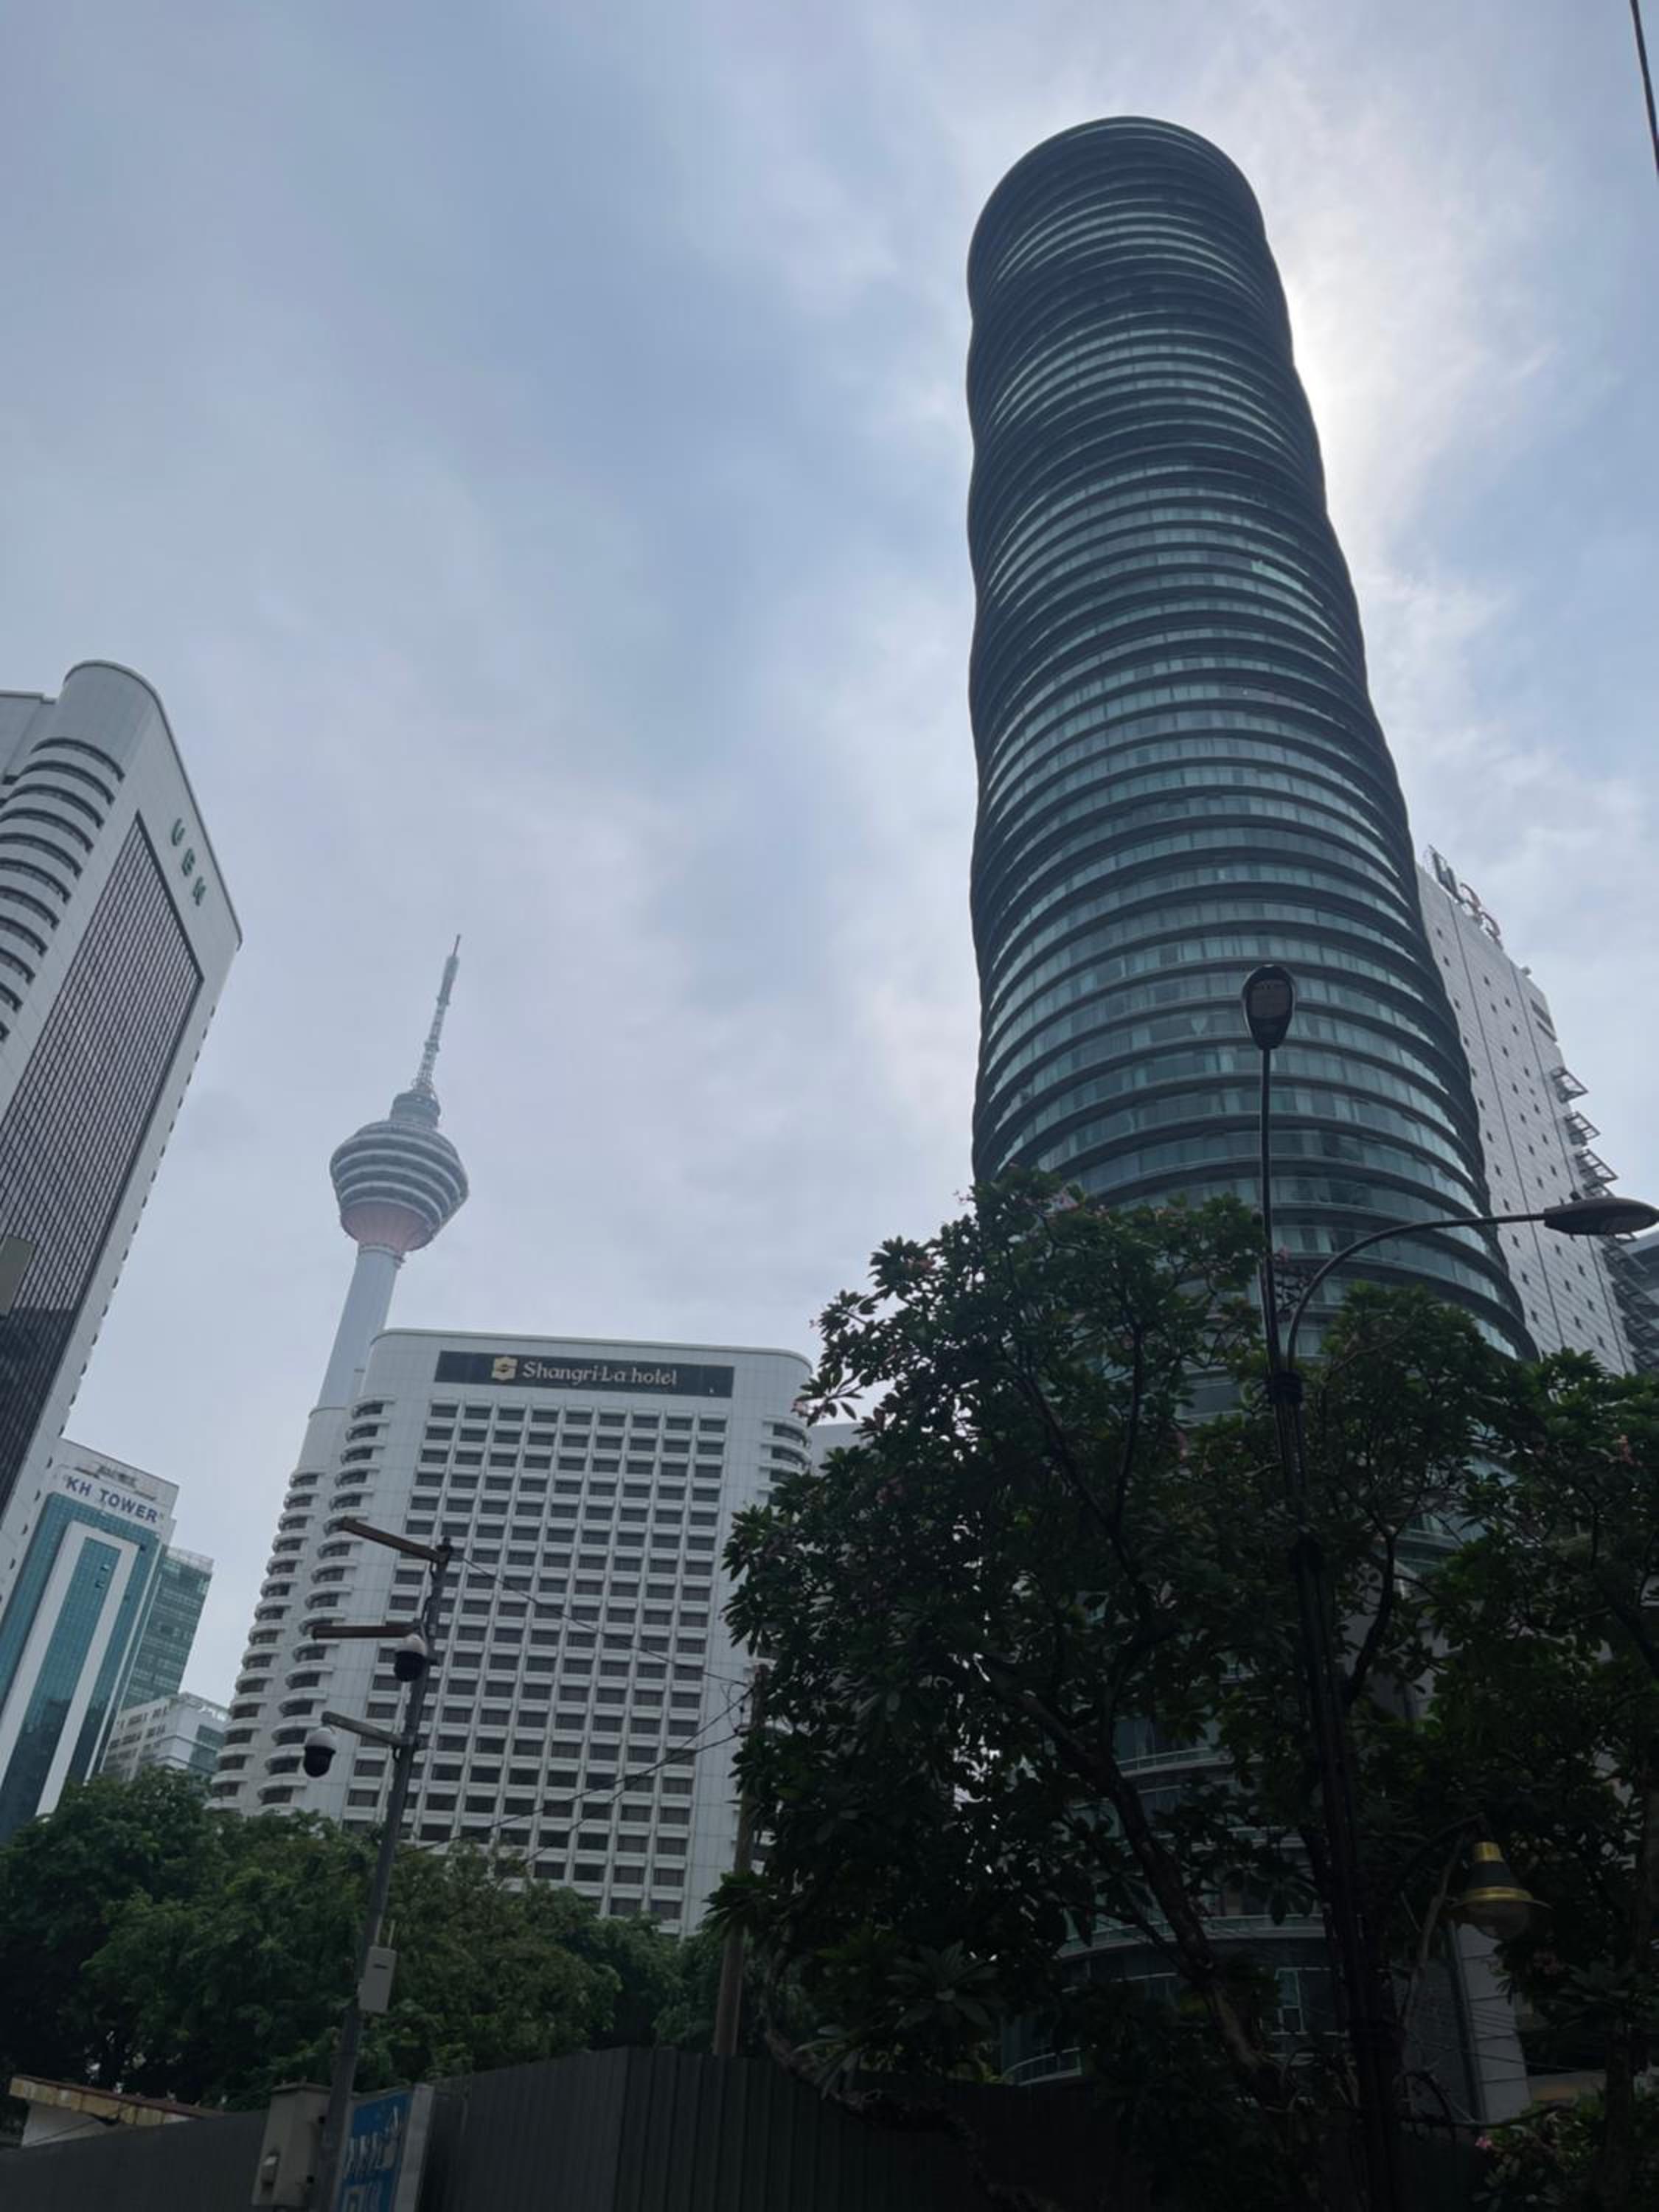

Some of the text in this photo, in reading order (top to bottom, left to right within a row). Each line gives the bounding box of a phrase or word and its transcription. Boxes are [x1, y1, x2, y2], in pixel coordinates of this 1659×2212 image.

[631, 1367, 677, 1385] hotel
[66, 1476, 158, 1523] KH TOWER
